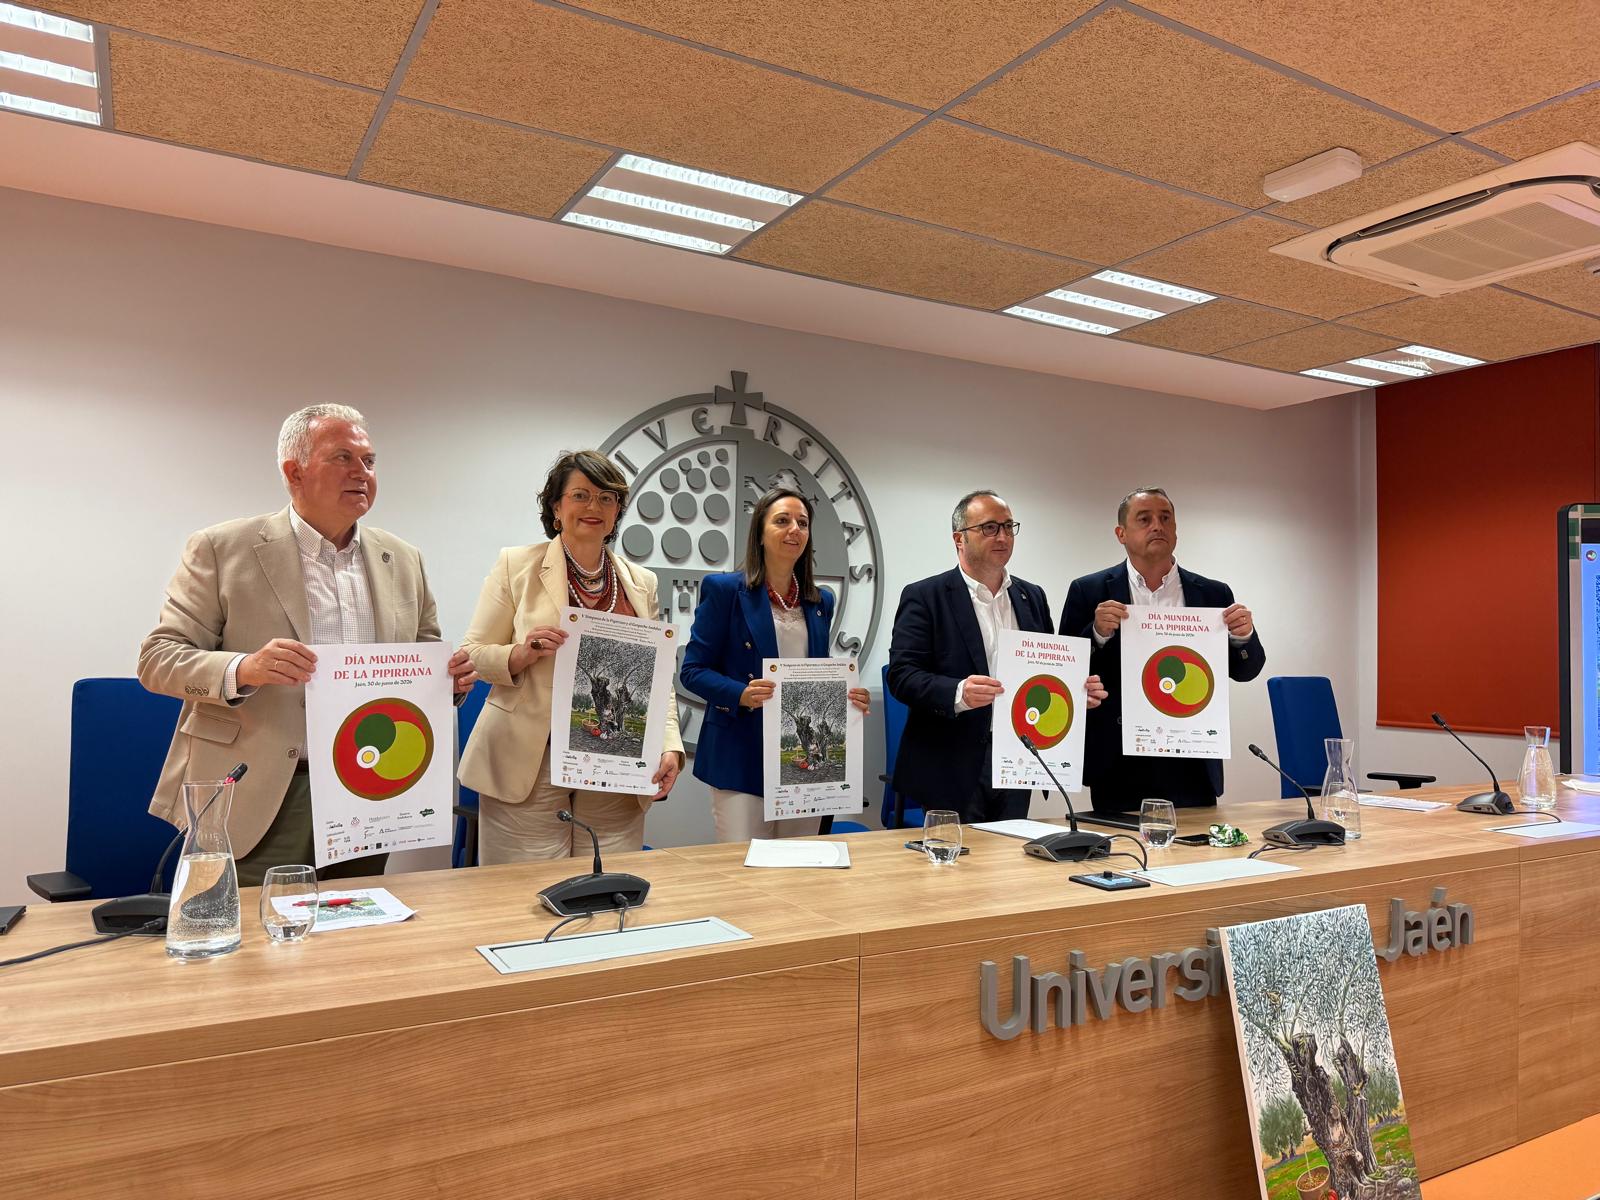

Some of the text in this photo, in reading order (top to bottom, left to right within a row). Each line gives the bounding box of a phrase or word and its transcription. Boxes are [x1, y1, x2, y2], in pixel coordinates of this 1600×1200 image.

[1163, 614, 1202, 623] MUNDIAL
[1141, 622, 1210, 632] DE LA PIPIRRANA
[1021, 638, 1070, 652] DÍA MUNDIAL
[344, 653, 422, 666] DÍA MUNDIAL
[1015, 649, 1025, 657] DE
[1027, 650, 1036, 659] LA
[1038, 652, 1076, 663] PIPIRRANA
[334, 667, 433, 680] DE LA PIPIRRANA
[981, 886, 1474, 1041] Universi Jaén
